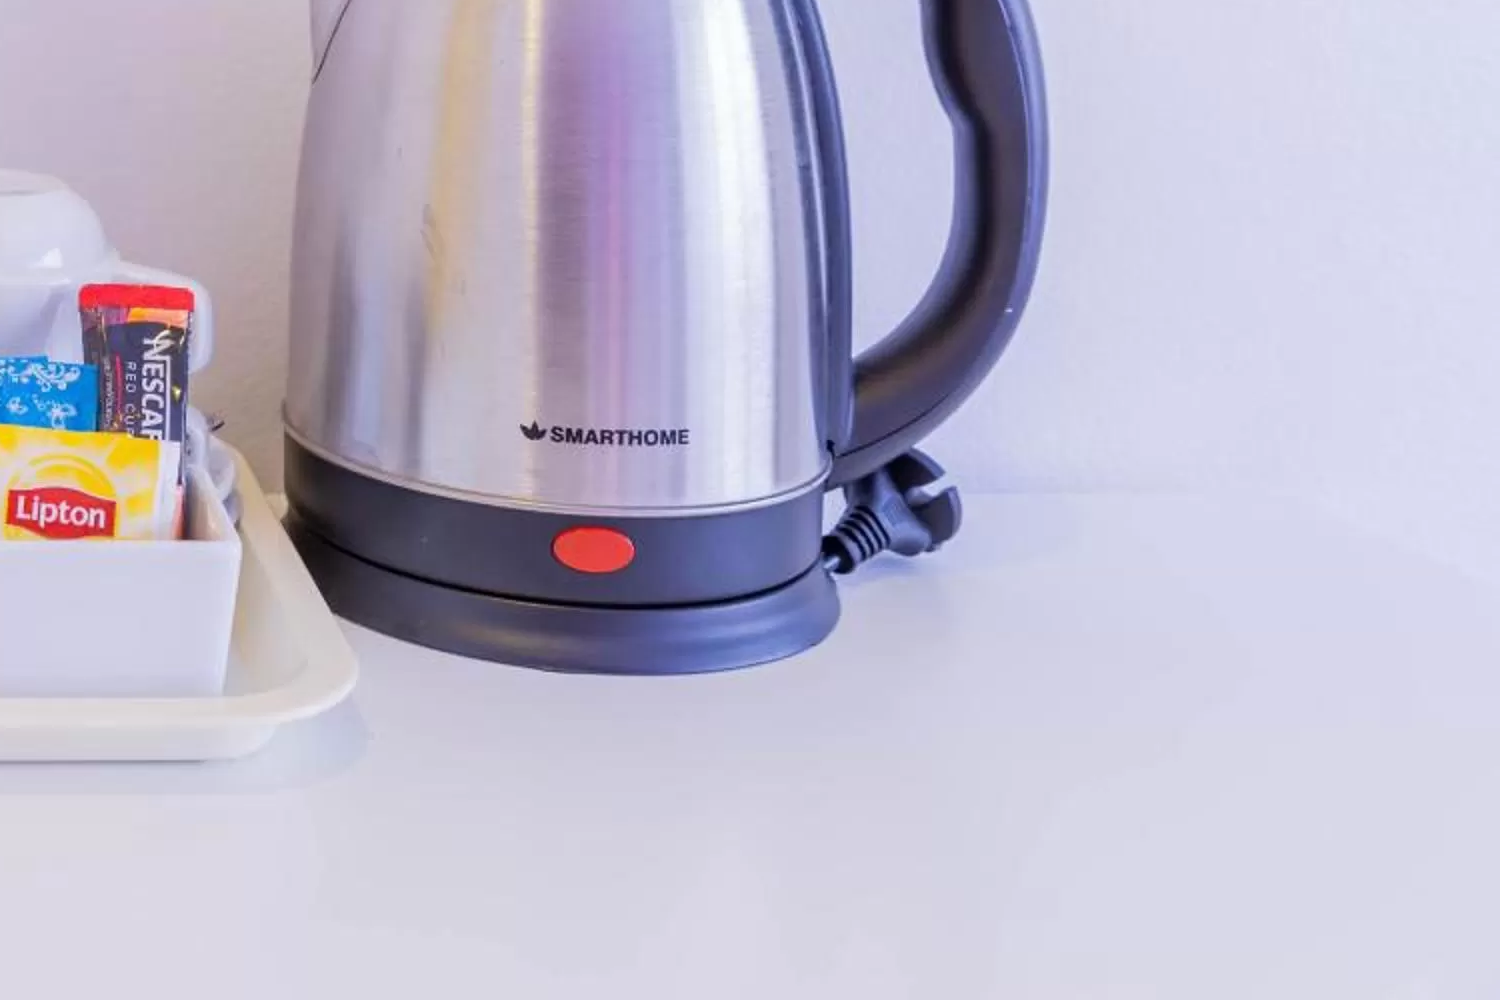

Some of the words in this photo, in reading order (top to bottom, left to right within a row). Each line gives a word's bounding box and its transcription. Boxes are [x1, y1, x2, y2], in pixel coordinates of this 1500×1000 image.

[140, 329, 173, 440] NESCAF
[550, 425, 690, 446] SMARTHOME
[15, 495, 106, 529] Lipton
